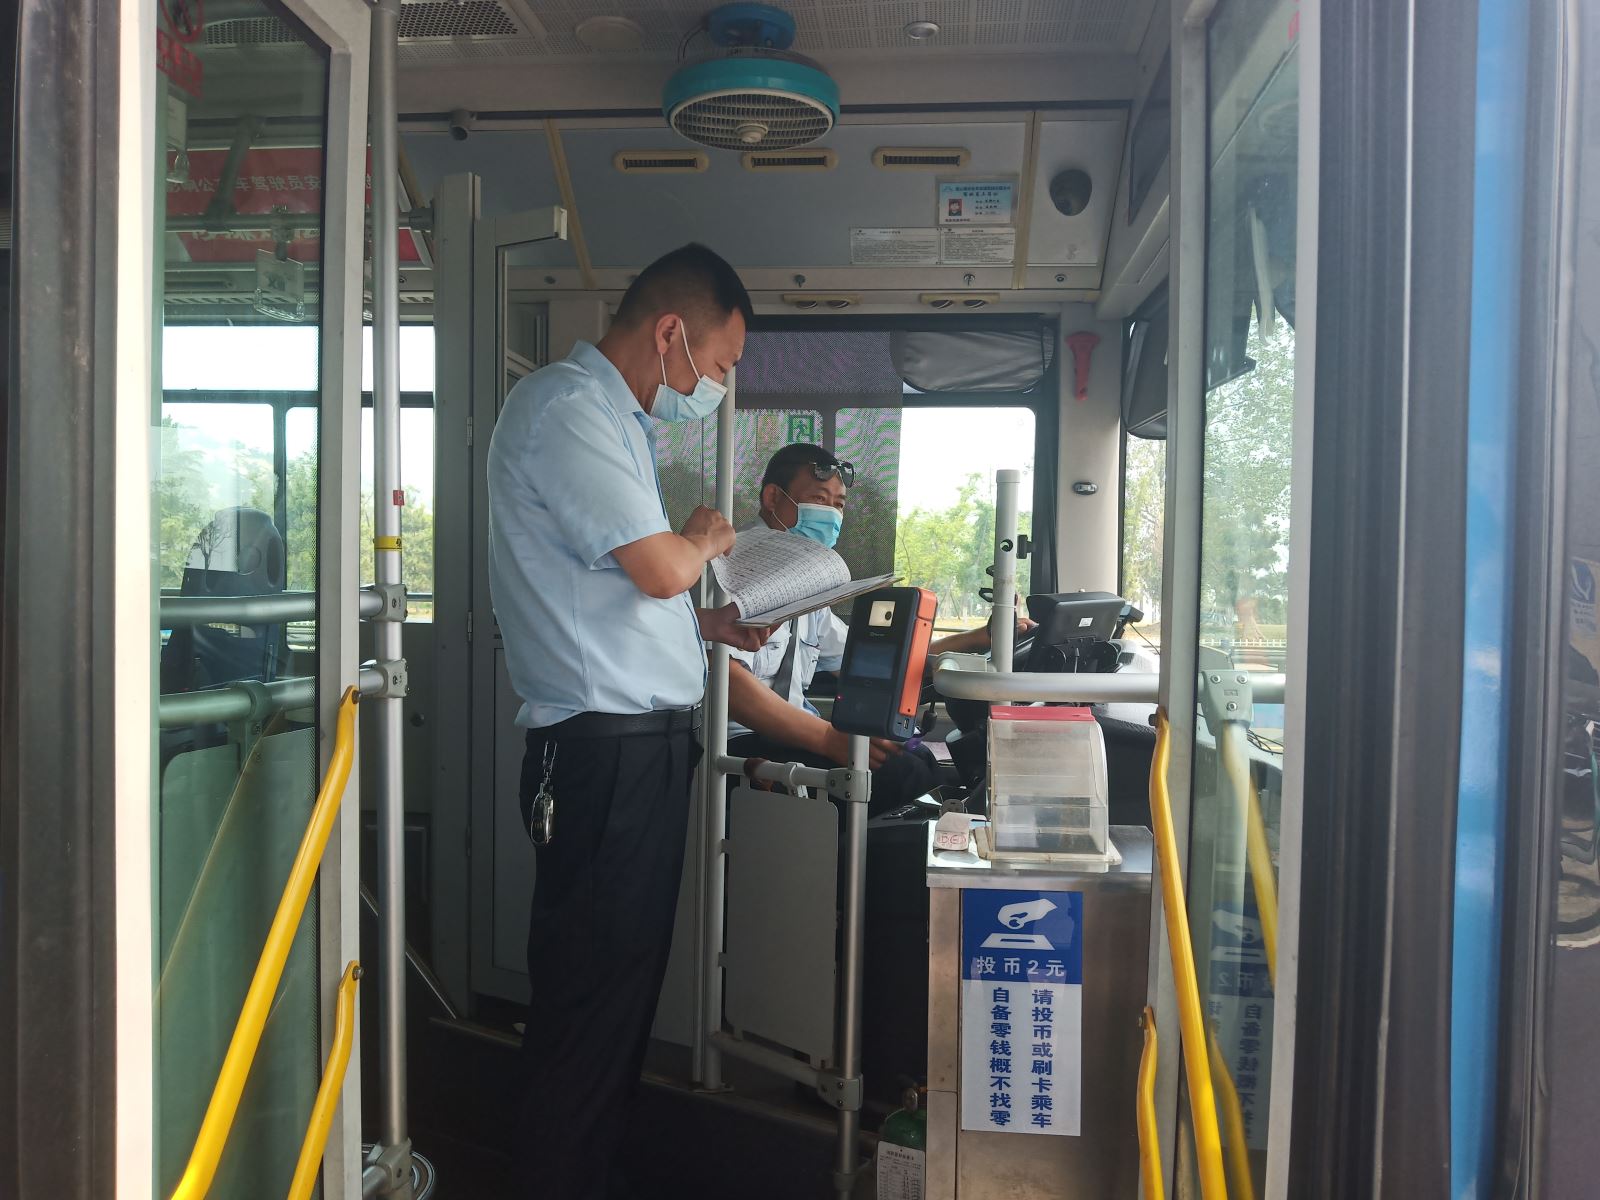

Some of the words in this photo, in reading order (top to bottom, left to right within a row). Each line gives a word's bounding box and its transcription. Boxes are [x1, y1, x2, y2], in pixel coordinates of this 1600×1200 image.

[976, 956, 1065, 977] 投币2元
[989, 987, 1012, 1126] 自备零钱概不找零
[1031, 988, 1054, 1128] 请投币或刷卡乘车
